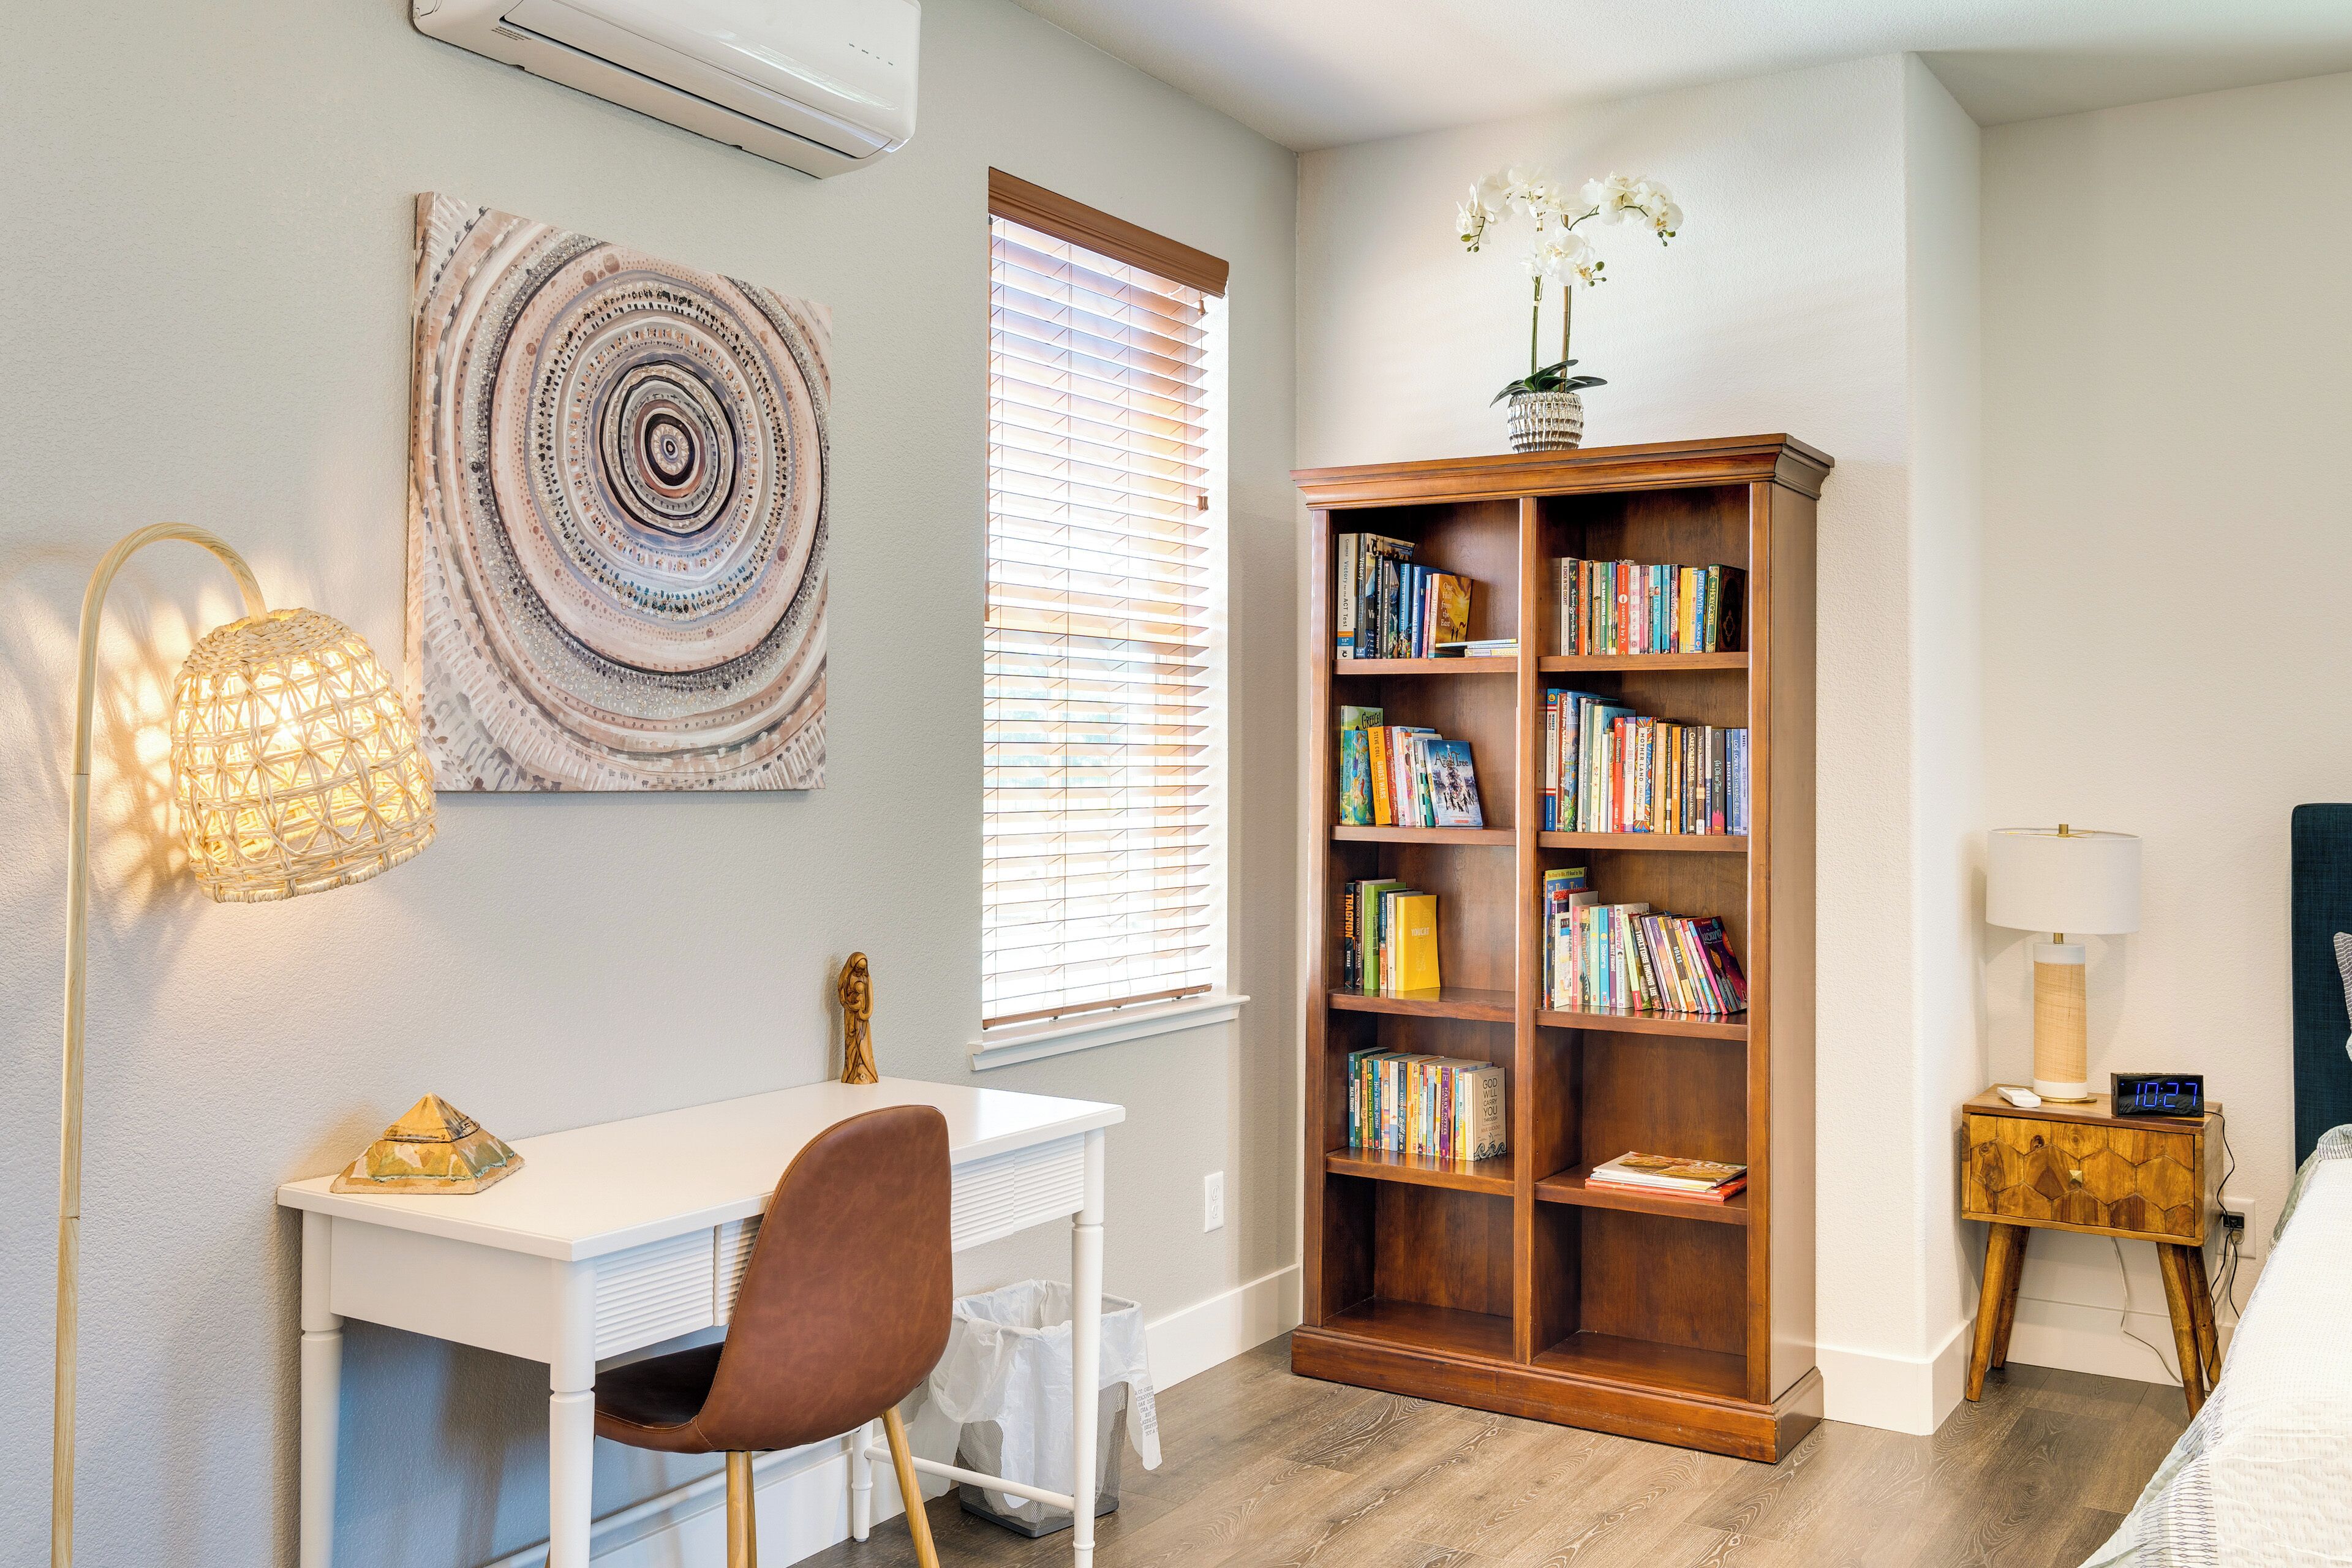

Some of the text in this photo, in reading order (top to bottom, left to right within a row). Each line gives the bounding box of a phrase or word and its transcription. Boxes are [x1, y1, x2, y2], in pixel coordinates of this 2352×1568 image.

[1443, 582, 1453, 590] One
[1442, 591, 1453, 600] Half
[1441, 600, 1452, 609] from
[1441, 619, 1450, 627] East
[1689, 747, 1695, 755] OF
[1345, 893, 1354, 938] TRACTION
[1411, 927, 1430, 936] YOUCAT
[1698, 927, 1722, 946] Luciana
[1673, 946, 1683, 964] HOLES
[1482, 1077, 1498, 1089] GOD
[1483, 1090, 1498, 1099] WILL
[2135, 1082, 2198, 1107] 10:27
[1483, 1098, 1498, 1107] CARRY
[1483, 1106, 1498, 1117] YOU
